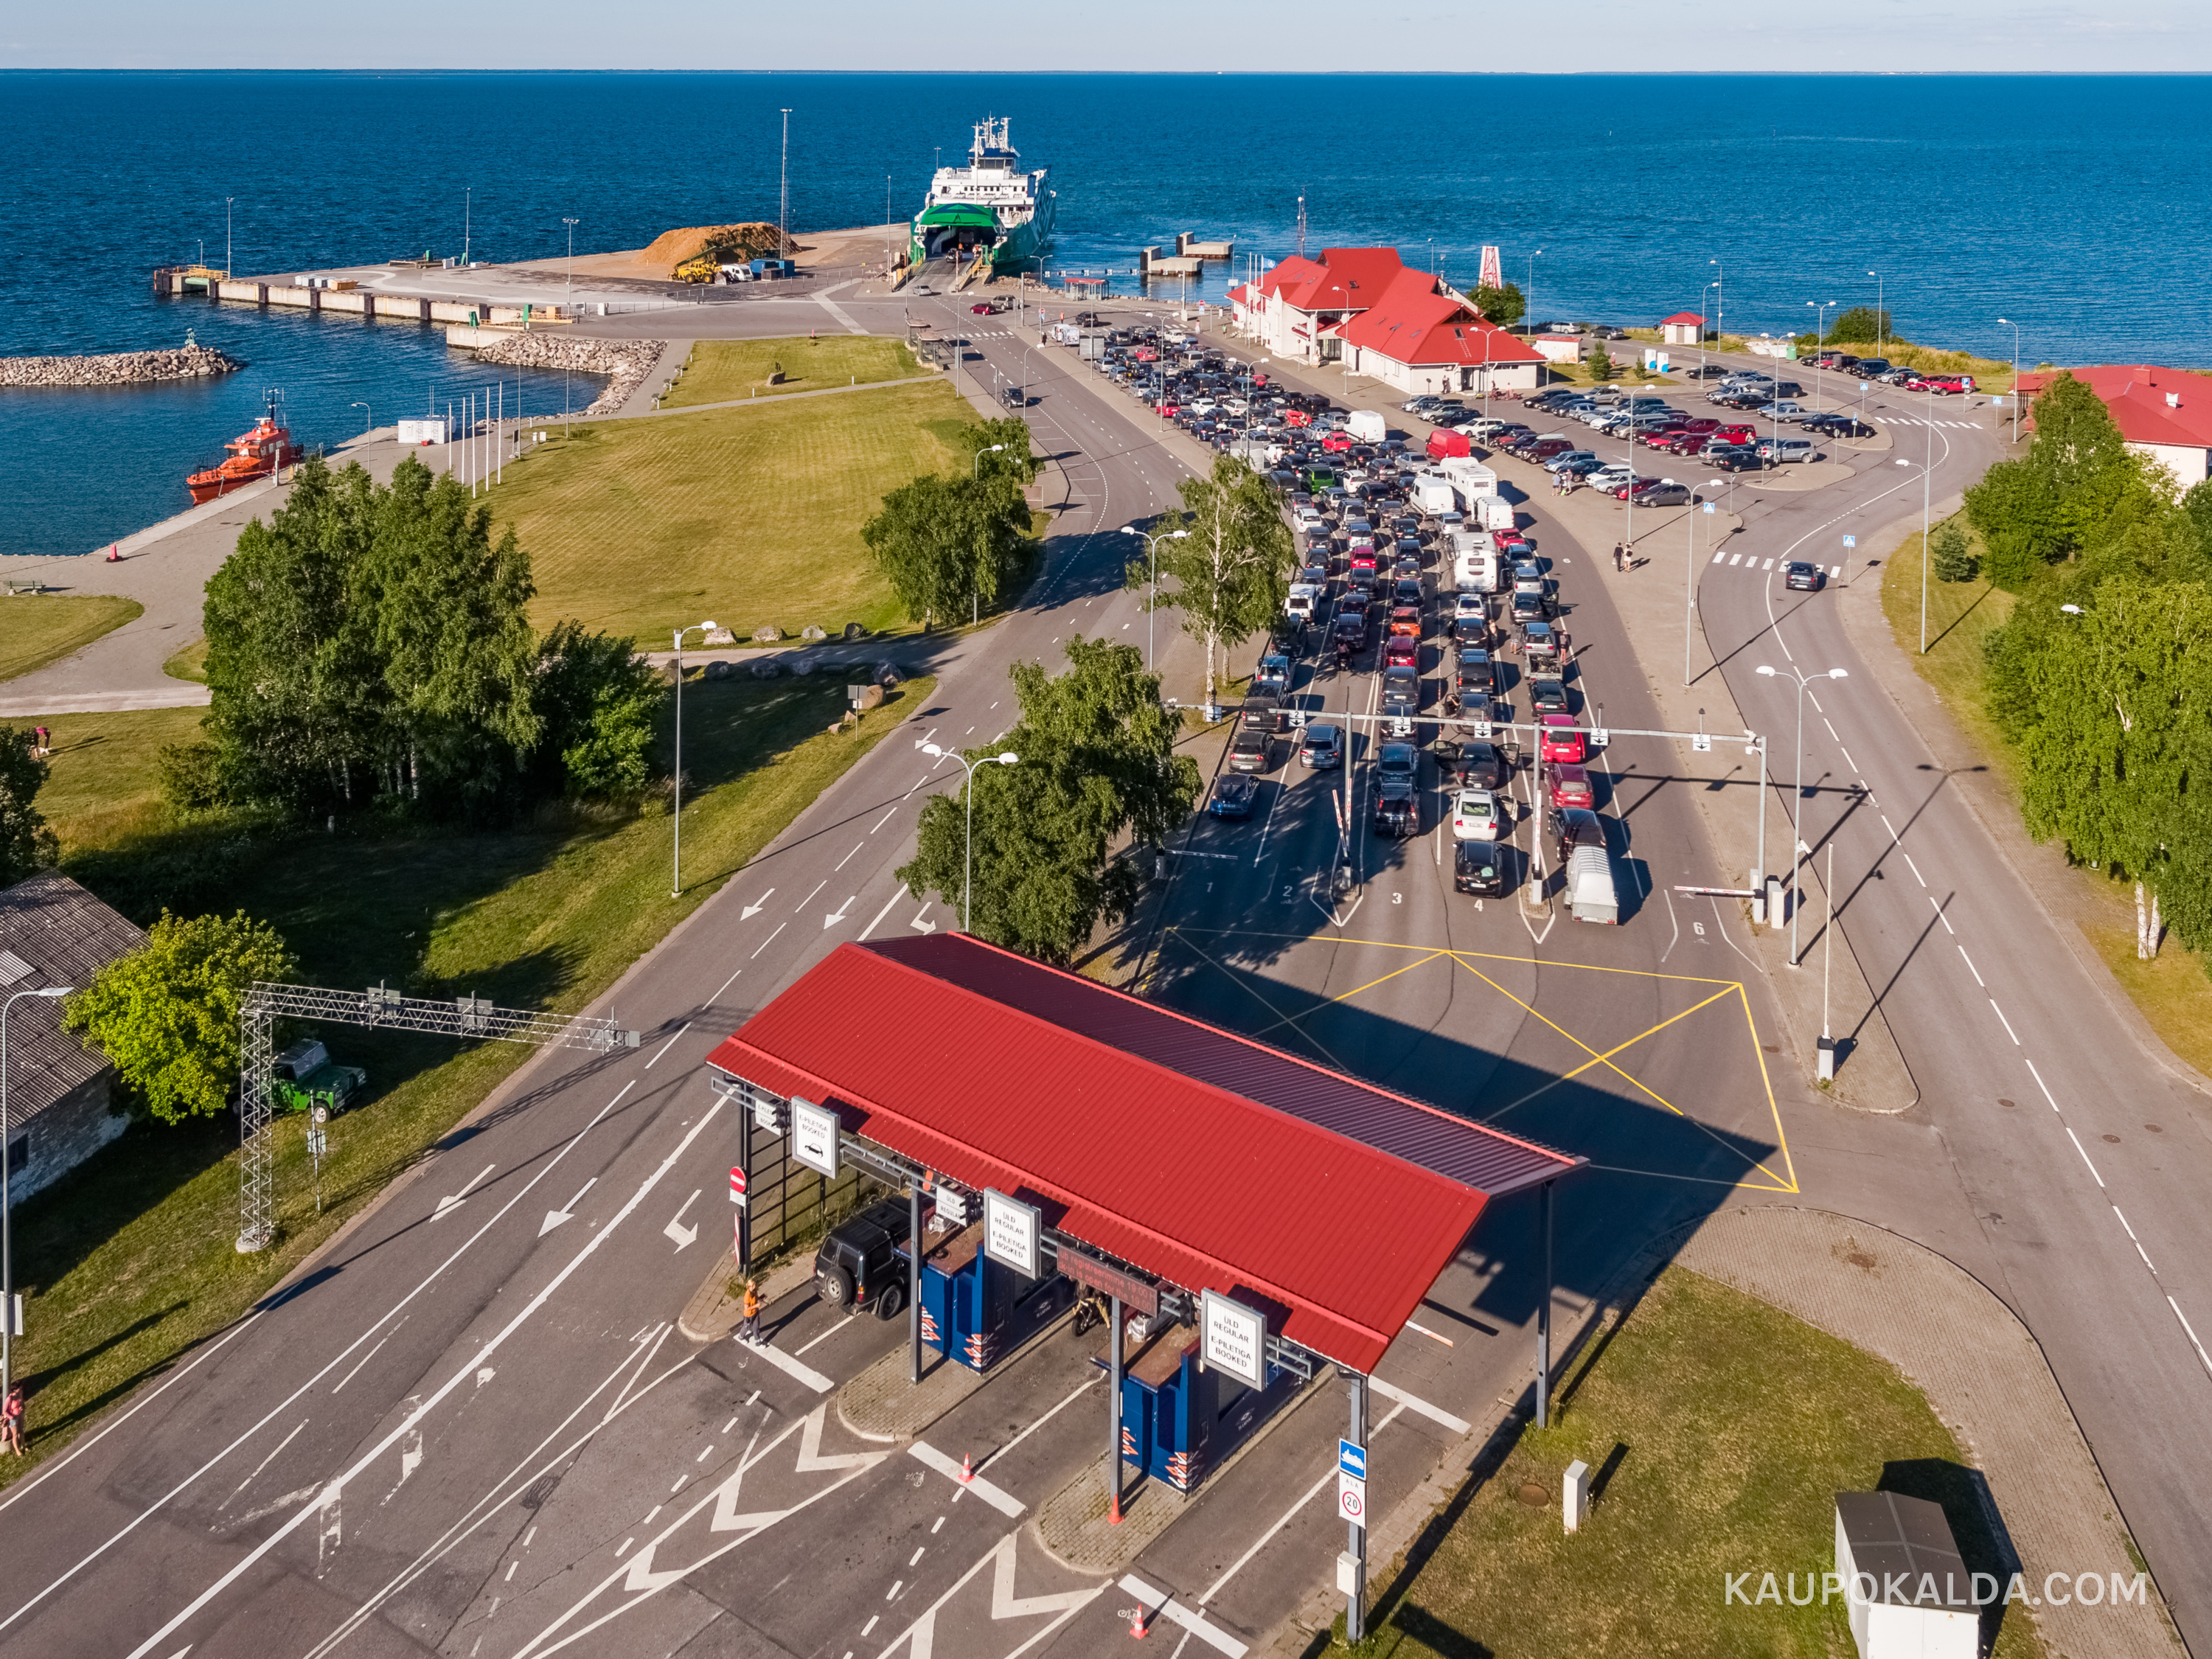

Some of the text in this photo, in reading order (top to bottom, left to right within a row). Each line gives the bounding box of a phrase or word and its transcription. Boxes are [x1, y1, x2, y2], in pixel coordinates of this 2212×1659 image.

[1206, 882, 1213, 893] 1
[1283, 886, 1293, 897] 2
[1392, 892, 1402, 904] 3
[1474, 899, 1484, 912] 4
[1693, 922, 1705, 936] 6
[802, 1124, 825, 1139] BOOKED
[995, 1217, 1024, 1237] REGULAR
[992, 1231, 1026, 1252] E-PILETIGA
[996, 1241, 1023, 1259] BOOKED
[1085, 1274, 1103, 1289] open
[1105, 1281, 1114, 1294] for
[1116, 1287, 1128, 1301] the
[1214, 1321, 1249, 1343] REGULAR
[1211, 1335, 1252, 1360] E-PILETIGA
[1215, 1346, 1248, 1368] BOOKED
[1346, 1478, 1358, 1489] ALA
[1346, 1496, 1357, 1509] 20
